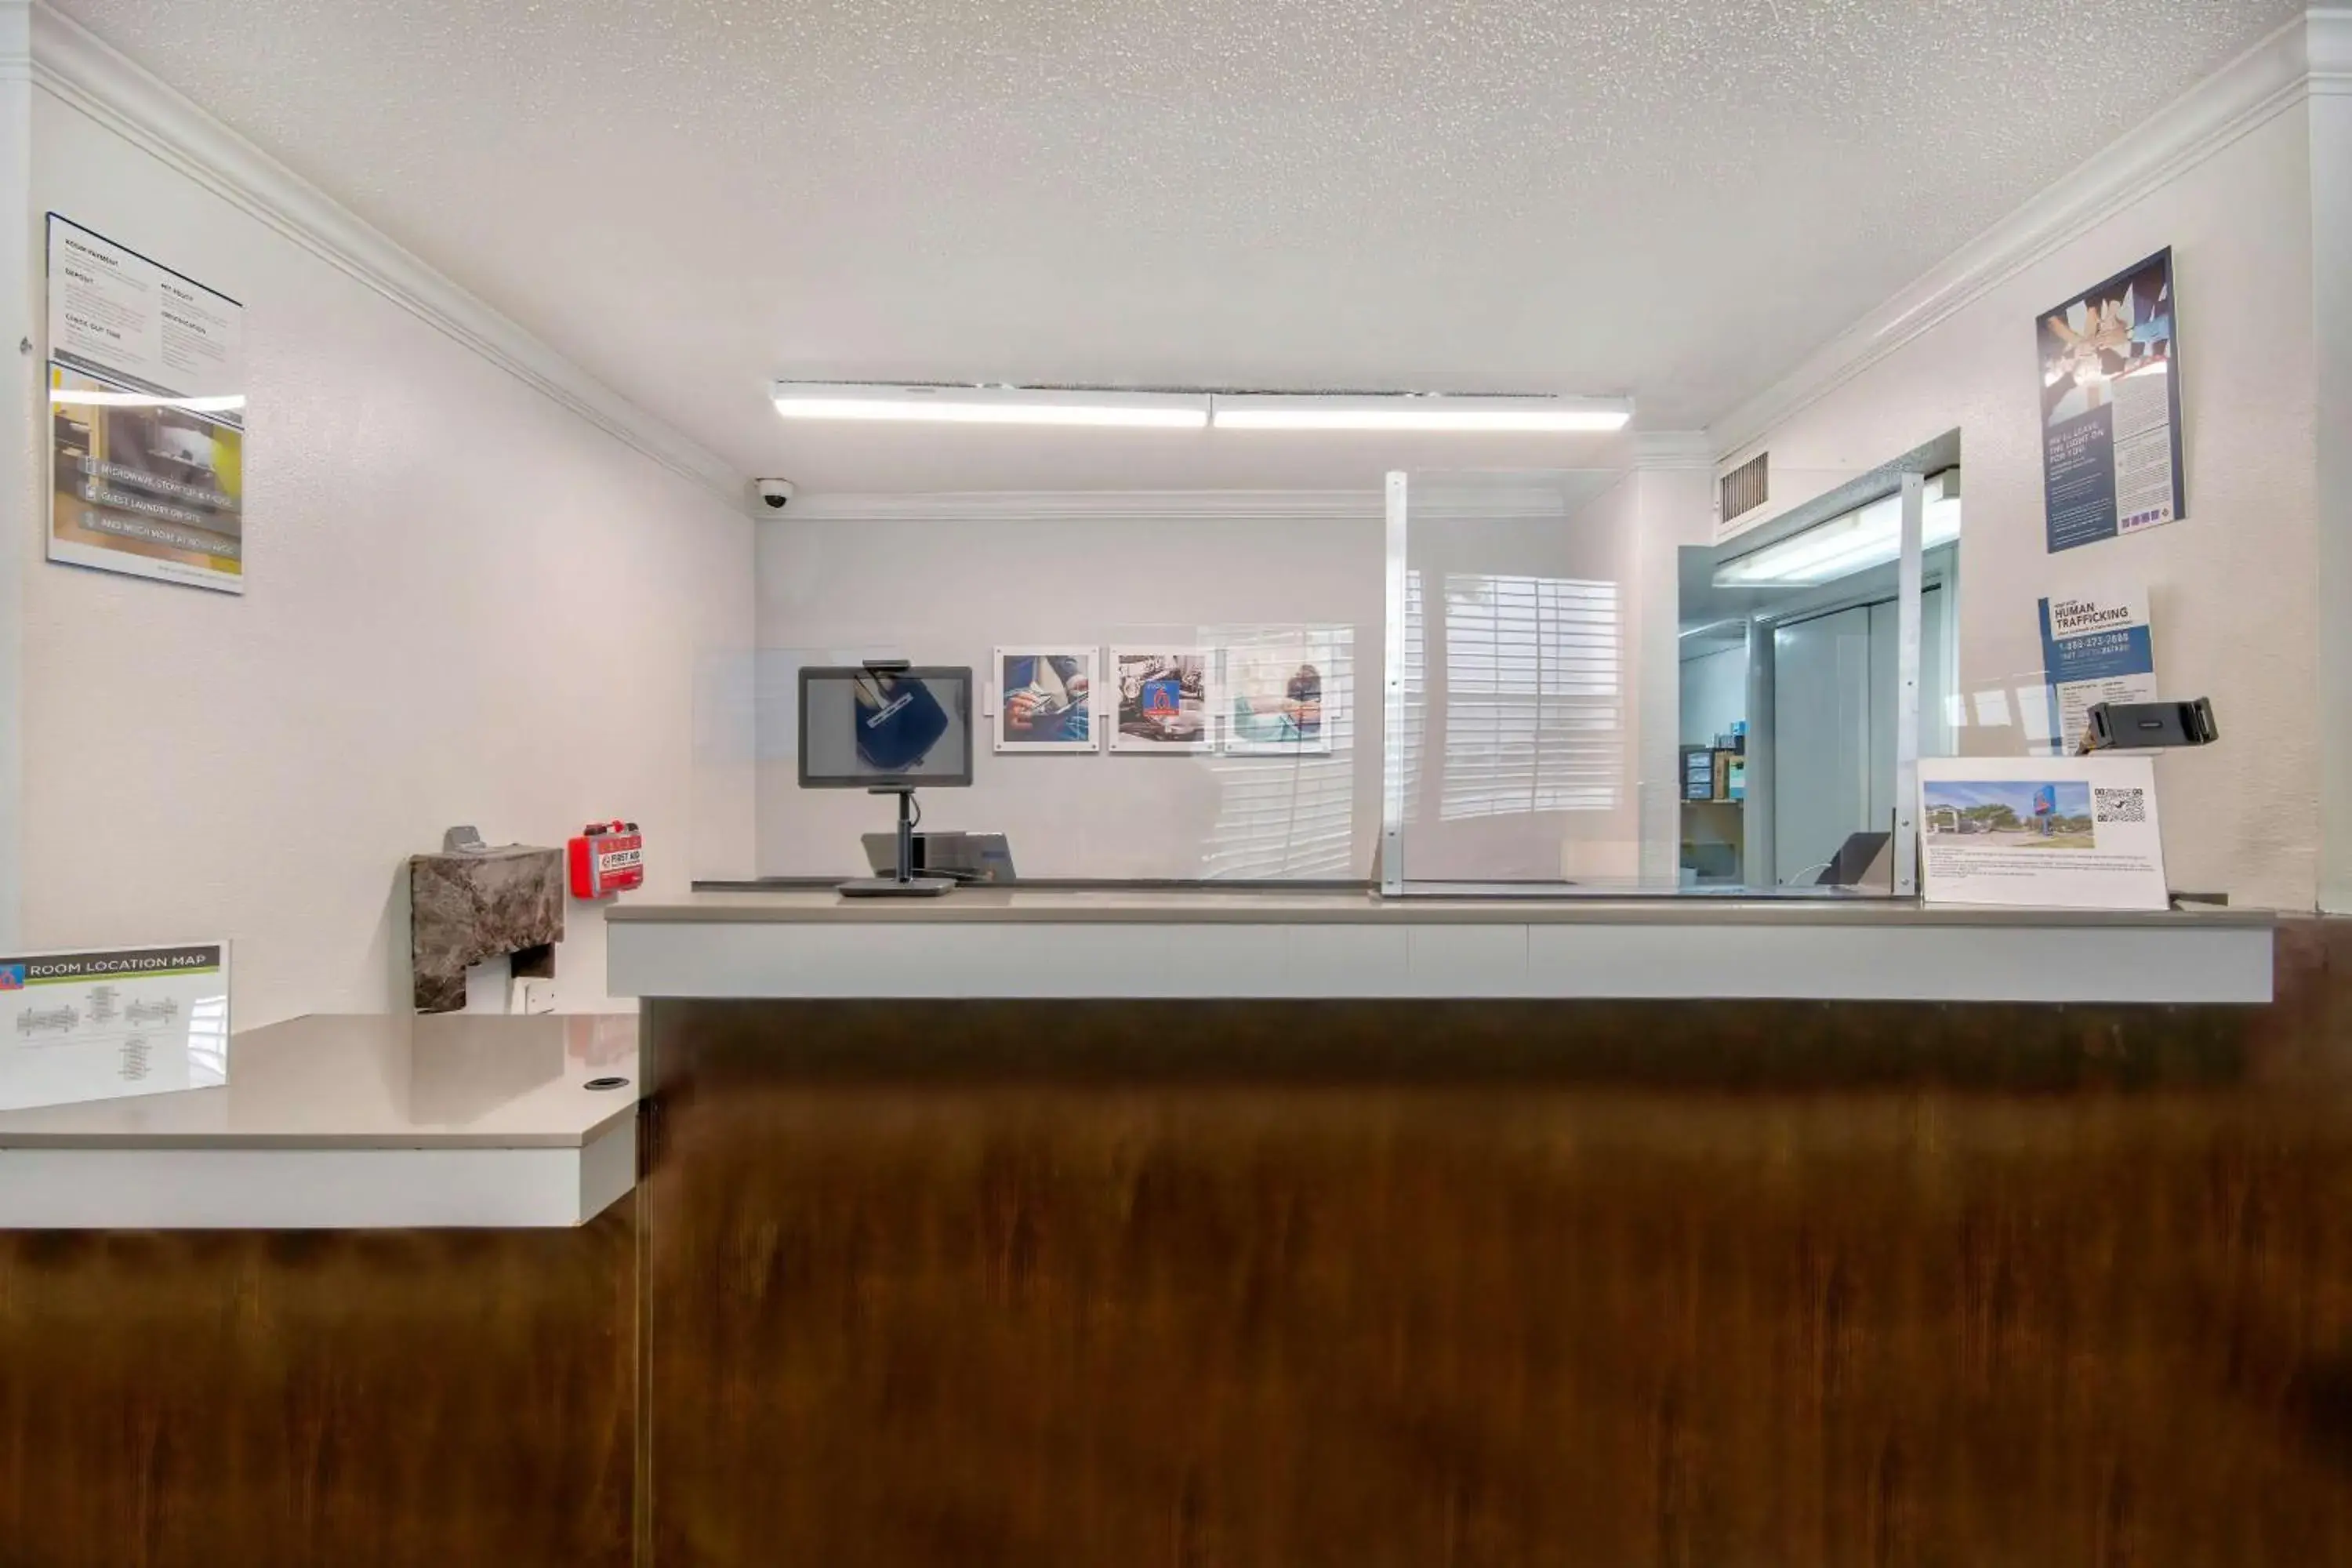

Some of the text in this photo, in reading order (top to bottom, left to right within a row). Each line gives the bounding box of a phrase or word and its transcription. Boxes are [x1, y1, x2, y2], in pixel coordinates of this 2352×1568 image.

[2055, 602, 2094, 619] HUMAN
[2056, 606, 2129, 629] TRAFFICKING
[612, 851, 641, 862] FIRST AID
[31, 954, 206, 975] ROOM LOCATION MAP
